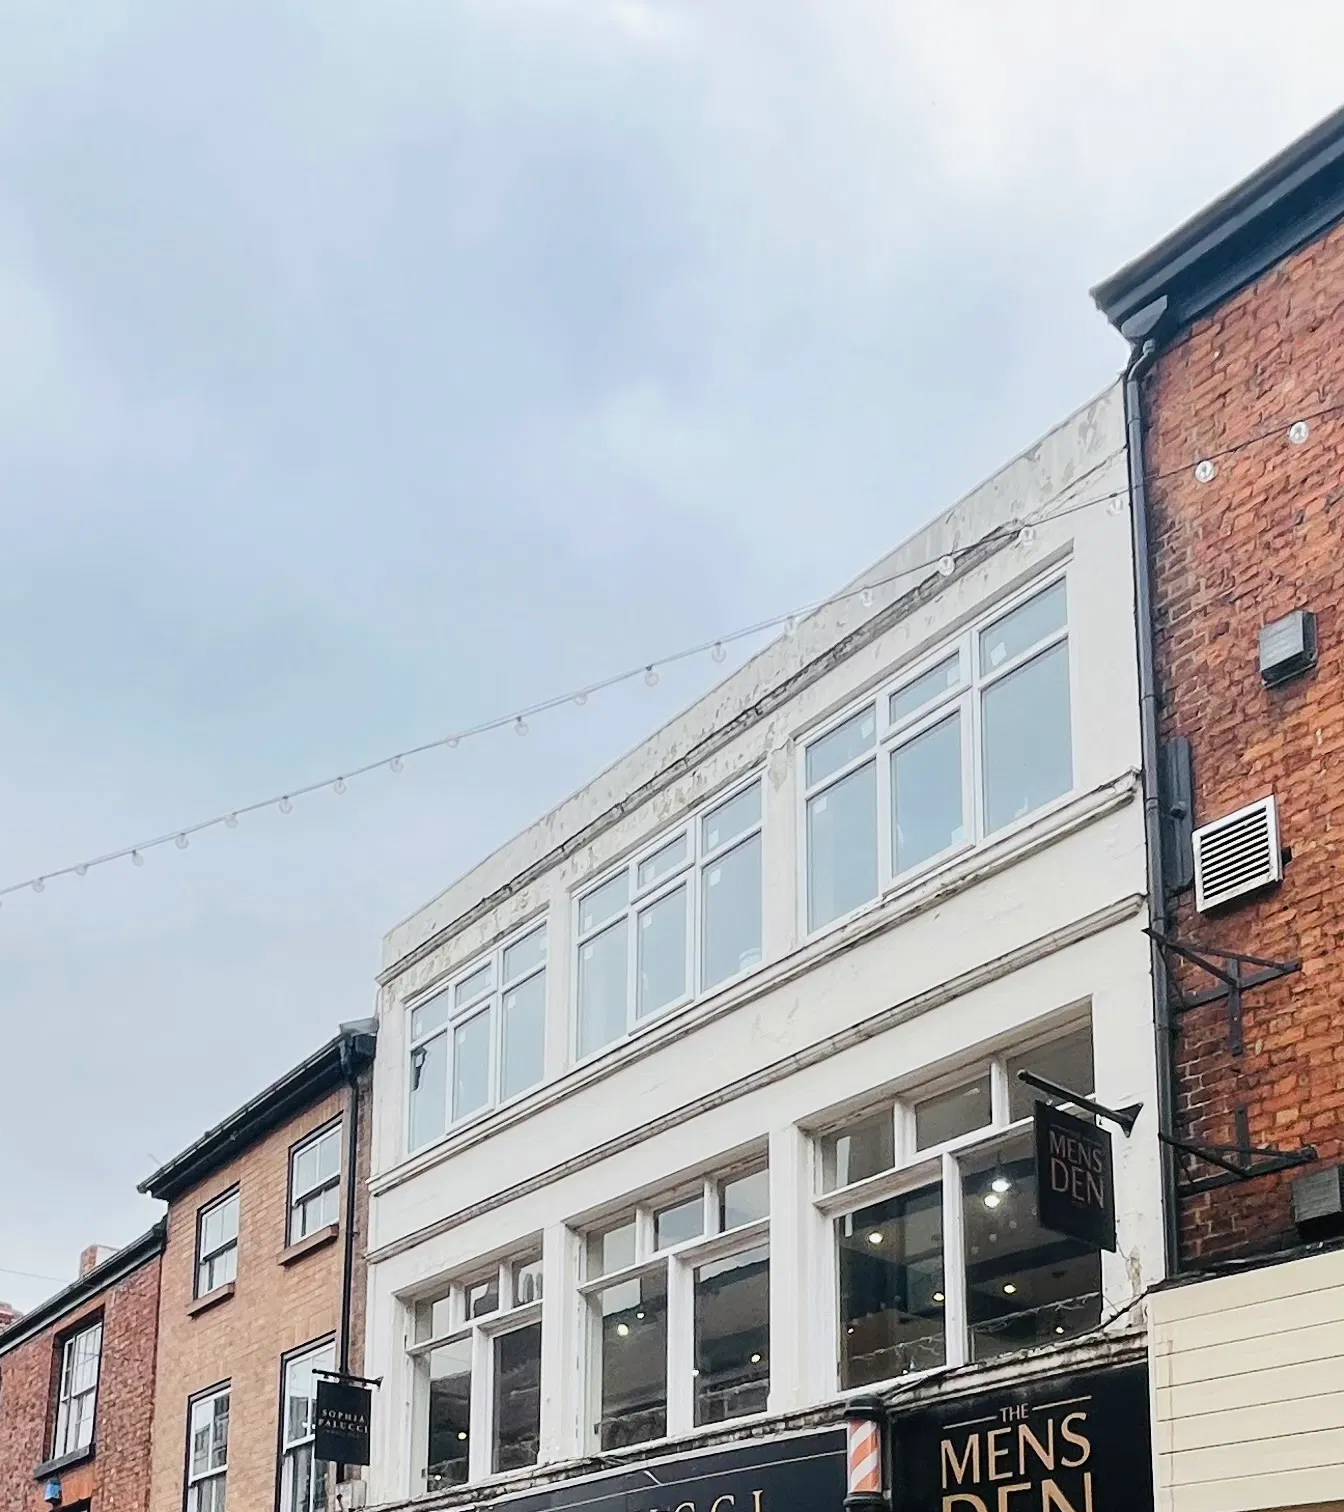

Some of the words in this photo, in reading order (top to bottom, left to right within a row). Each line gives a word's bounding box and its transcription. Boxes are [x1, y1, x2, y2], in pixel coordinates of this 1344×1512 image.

[1049, 1130, 1104, 1174] MENS
[1051, 1156, 1104, 1209] DEN
[318, 1418, 368, 1434] PALUCCI
[322, 1408, 365, 1423] SOPHIA
[1000, 1403, 1029, 1423] THE
[941, 1412, 1091, 1489] MENS
